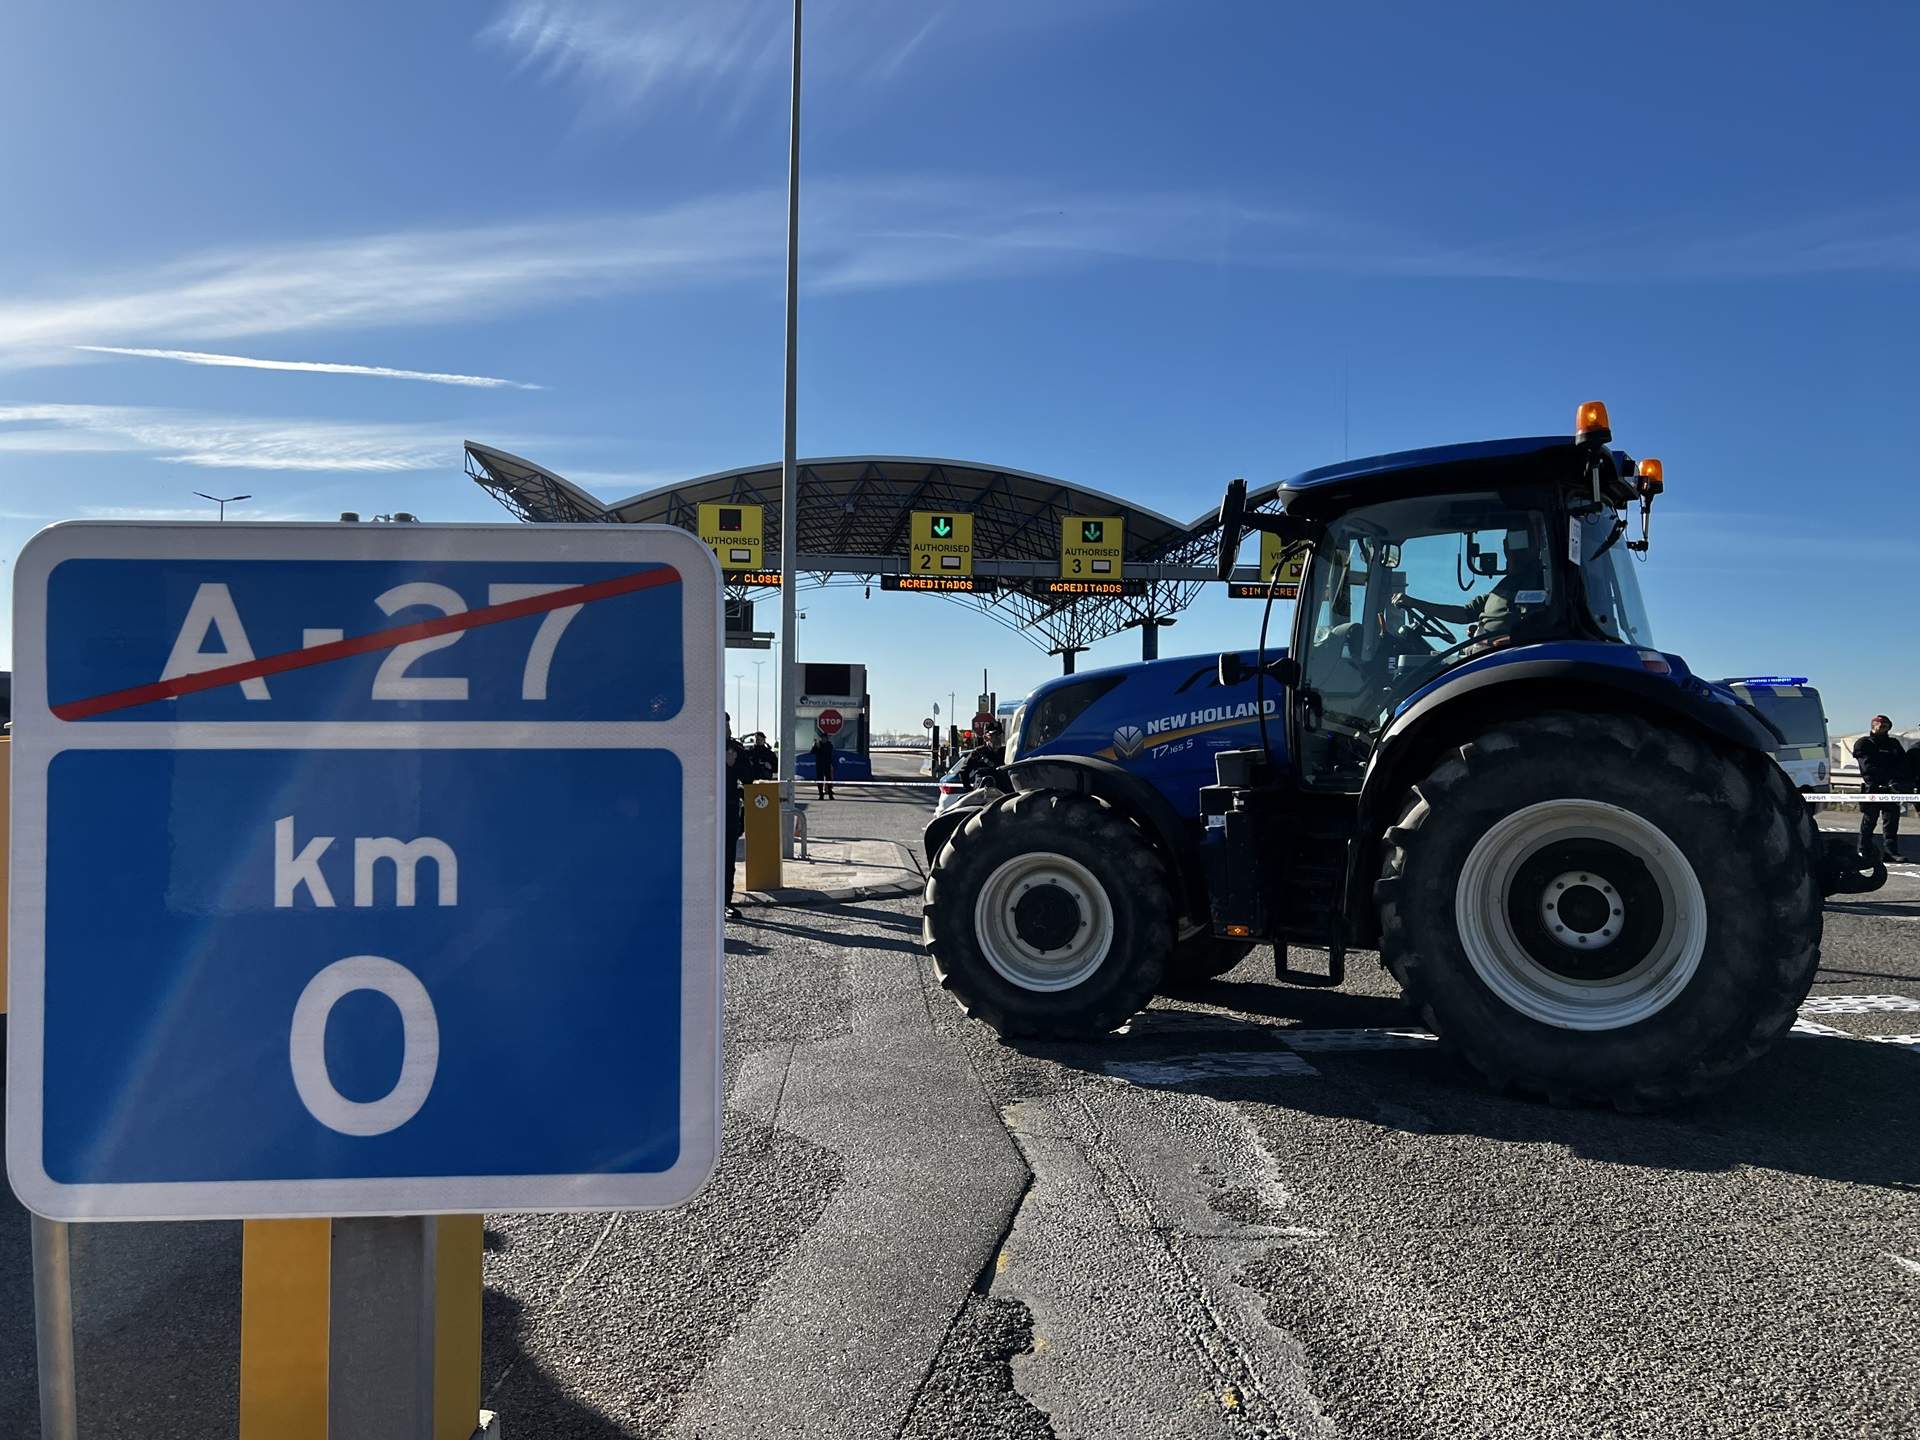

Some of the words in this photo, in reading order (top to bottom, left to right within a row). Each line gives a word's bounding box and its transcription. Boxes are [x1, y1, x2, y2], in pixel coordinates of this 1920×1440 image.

[701, 536, 760, 546] AUTHORISED
[913, 543, 970, 553] AUTHORISED
[1065, 548, 1120, 557] AUTHORISED
[921, 554, 932, 570] 2
[1072, 558, 1082, 574] 3
[899, 579, 973, 590] ACREDITADOS
[1050, 583, 1122, 593] ACREDITADOS
[1241, 587, 1261, 595] SIN
[159, 582, 589, 701] A-27
[1147, 713, 1187, 735] NEW
[1190, 700, 1276, 726] HOLLAND
[274, 816, 459, 908] km
[290, 955, 439, 1137] 0
